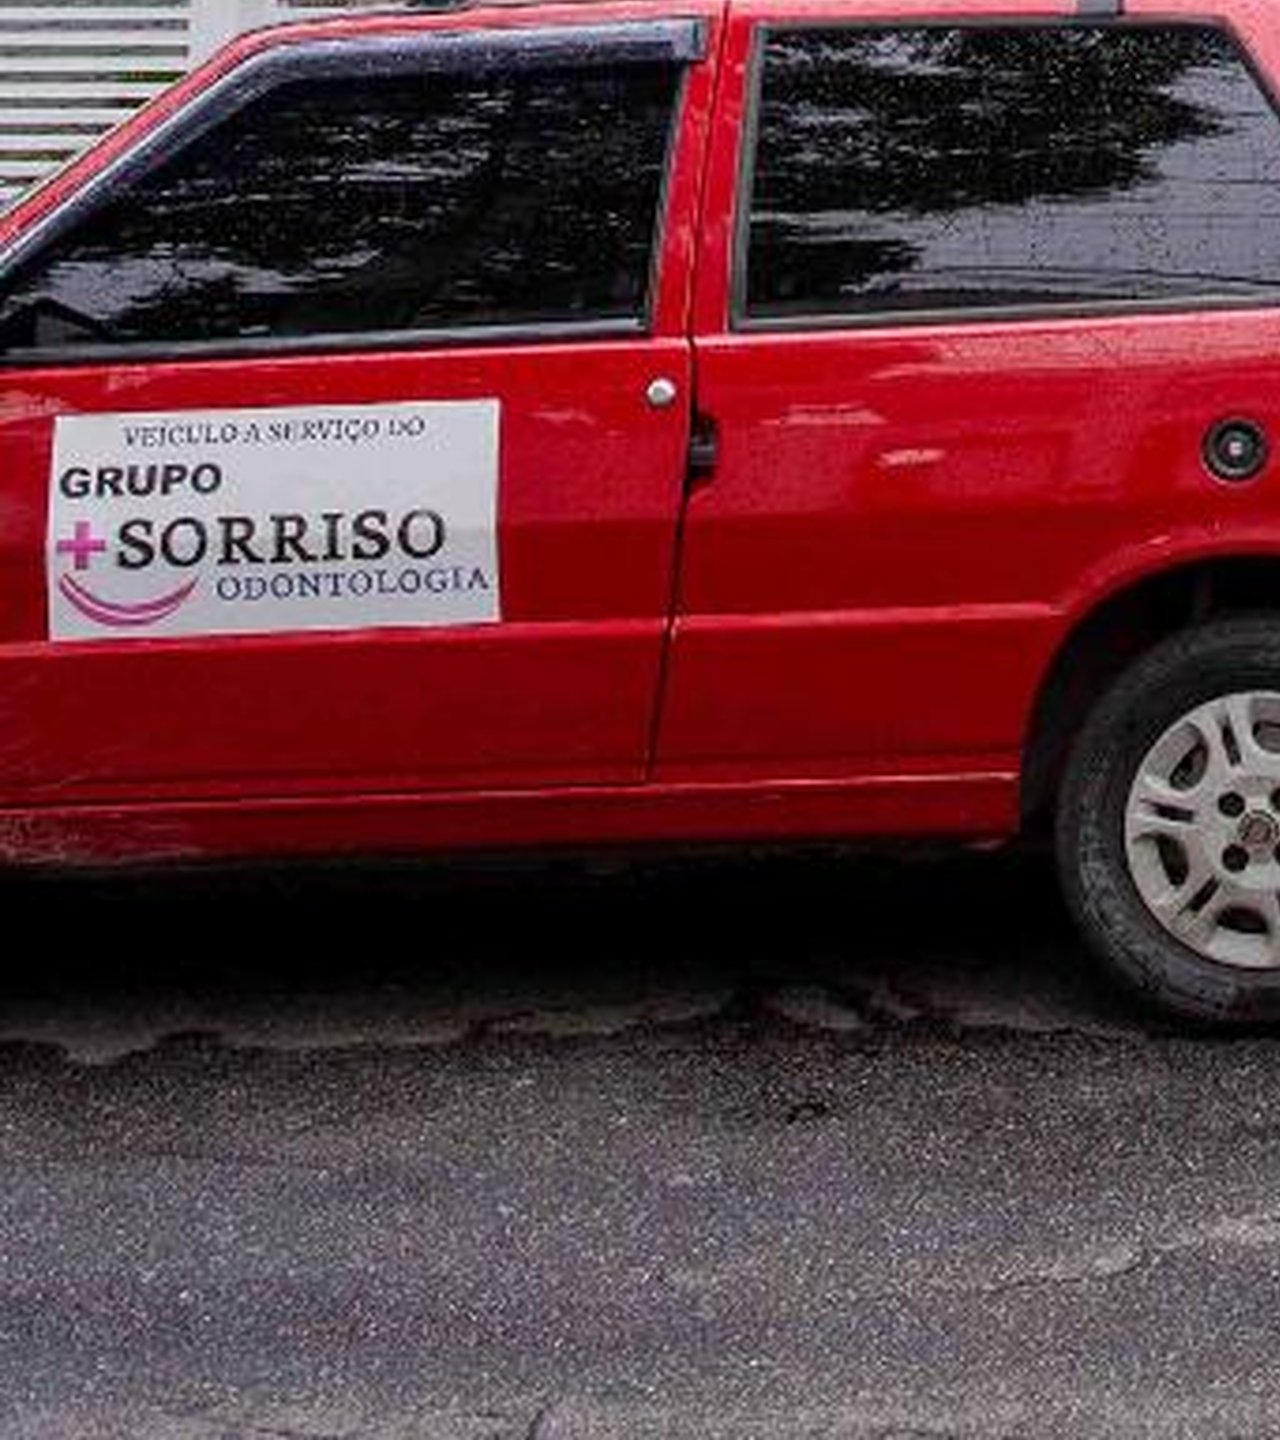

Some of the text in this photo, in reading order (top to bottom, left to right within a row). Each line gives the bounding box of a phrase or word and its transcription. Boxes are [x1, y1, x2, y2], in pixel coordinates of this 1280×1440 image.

[125, 420, 237, 447] VEÍCULO
[243, 423, 261, 443] A
[268, 417, 380, 444] SERVIÇO
[59, 461, 223, 499] GRUPO
[216, 566, 489, 602] ODONTOLOGIA
